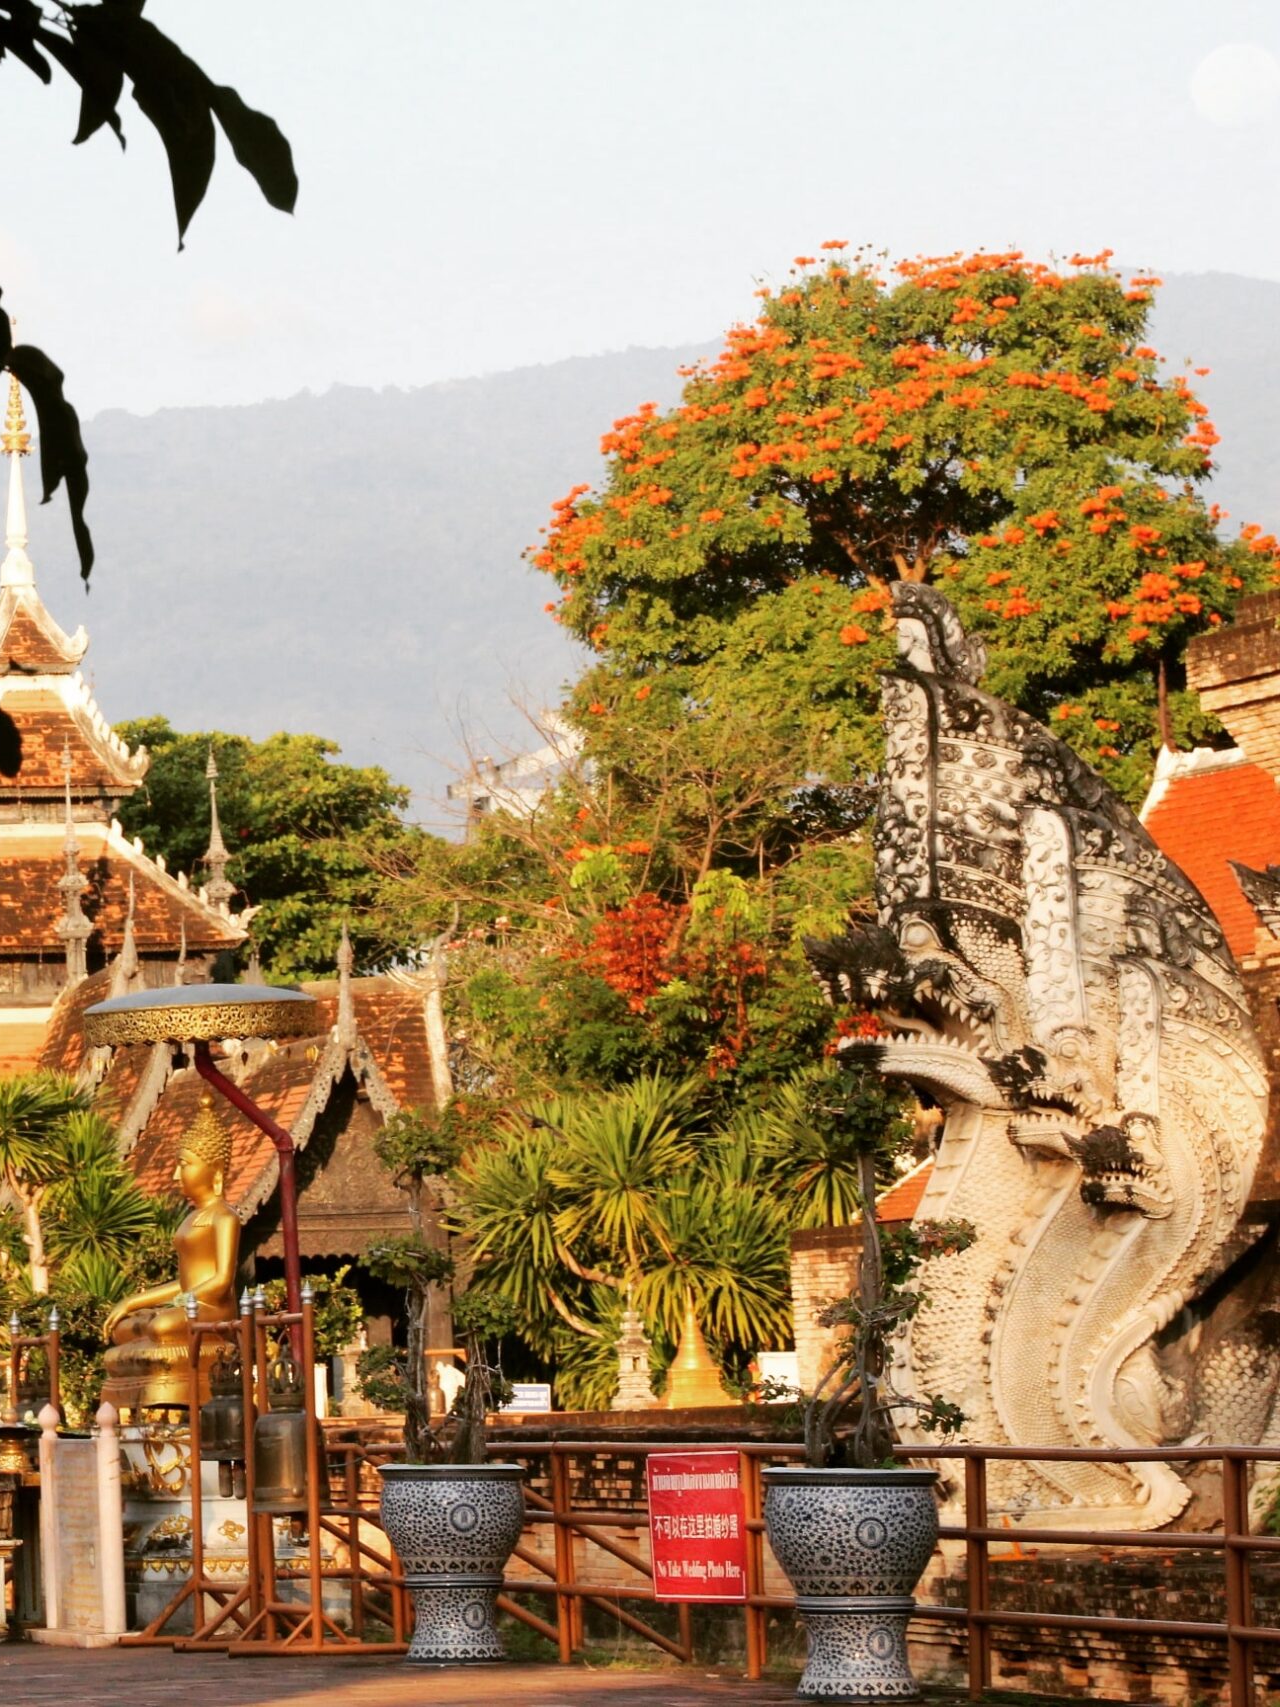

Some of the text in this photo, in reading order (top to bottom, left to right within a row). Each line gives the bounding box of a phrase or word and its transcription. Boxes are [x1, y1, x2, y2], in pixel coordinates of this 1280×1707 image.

[657, 1560, 667, 1578] No
[667, 1560, 682, 1578] Take
[707, 1560, 725, 1578] Photo
